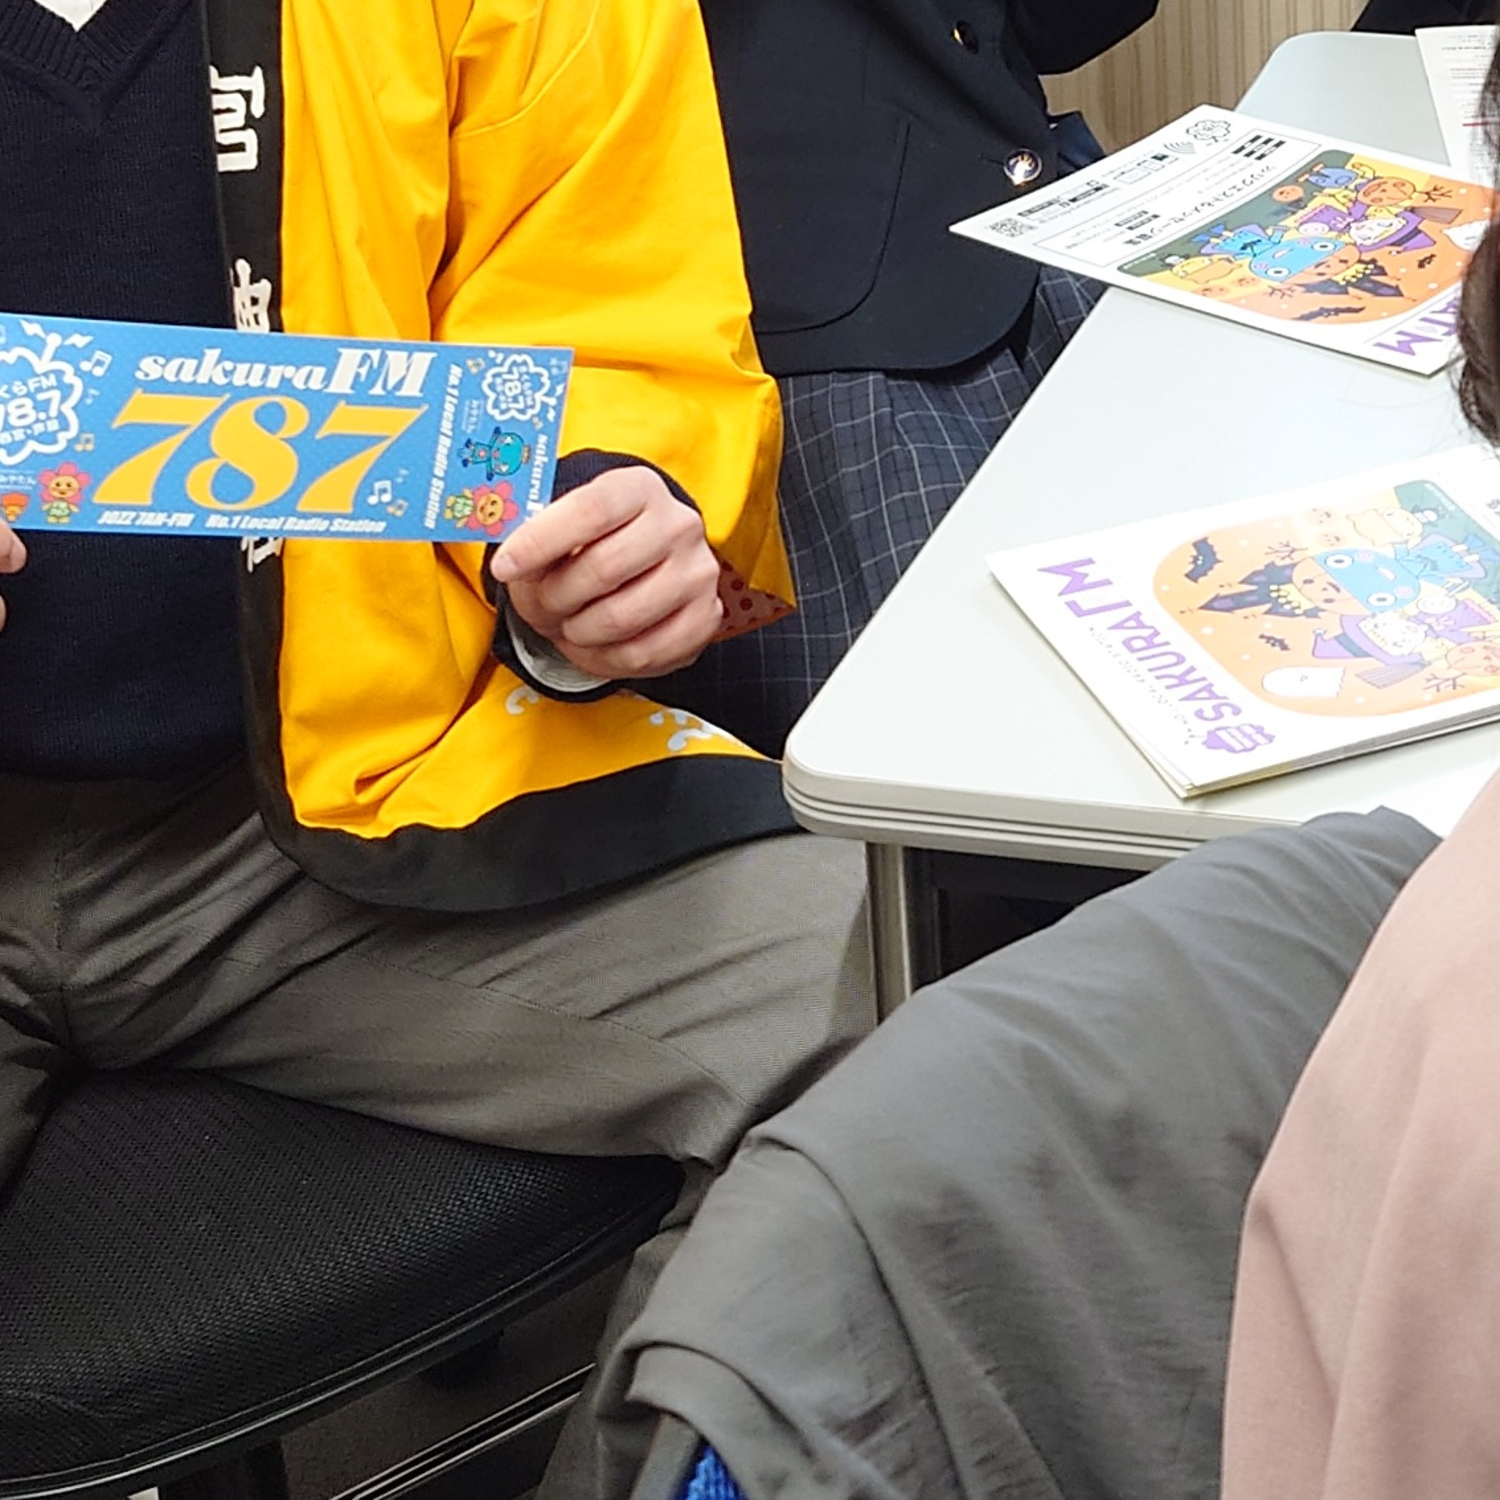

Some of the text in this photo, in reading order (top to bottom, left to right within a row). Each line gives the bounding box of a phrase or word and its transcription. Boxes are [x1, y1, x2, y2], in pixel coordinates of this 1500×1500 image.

[0, 373, 56, 398] くらFM
[134, 347, 437, 397] sakuraFM
[91, 387, 429, 513] 787
[204, 514, 387, 534] No.1 Local Radio Station
